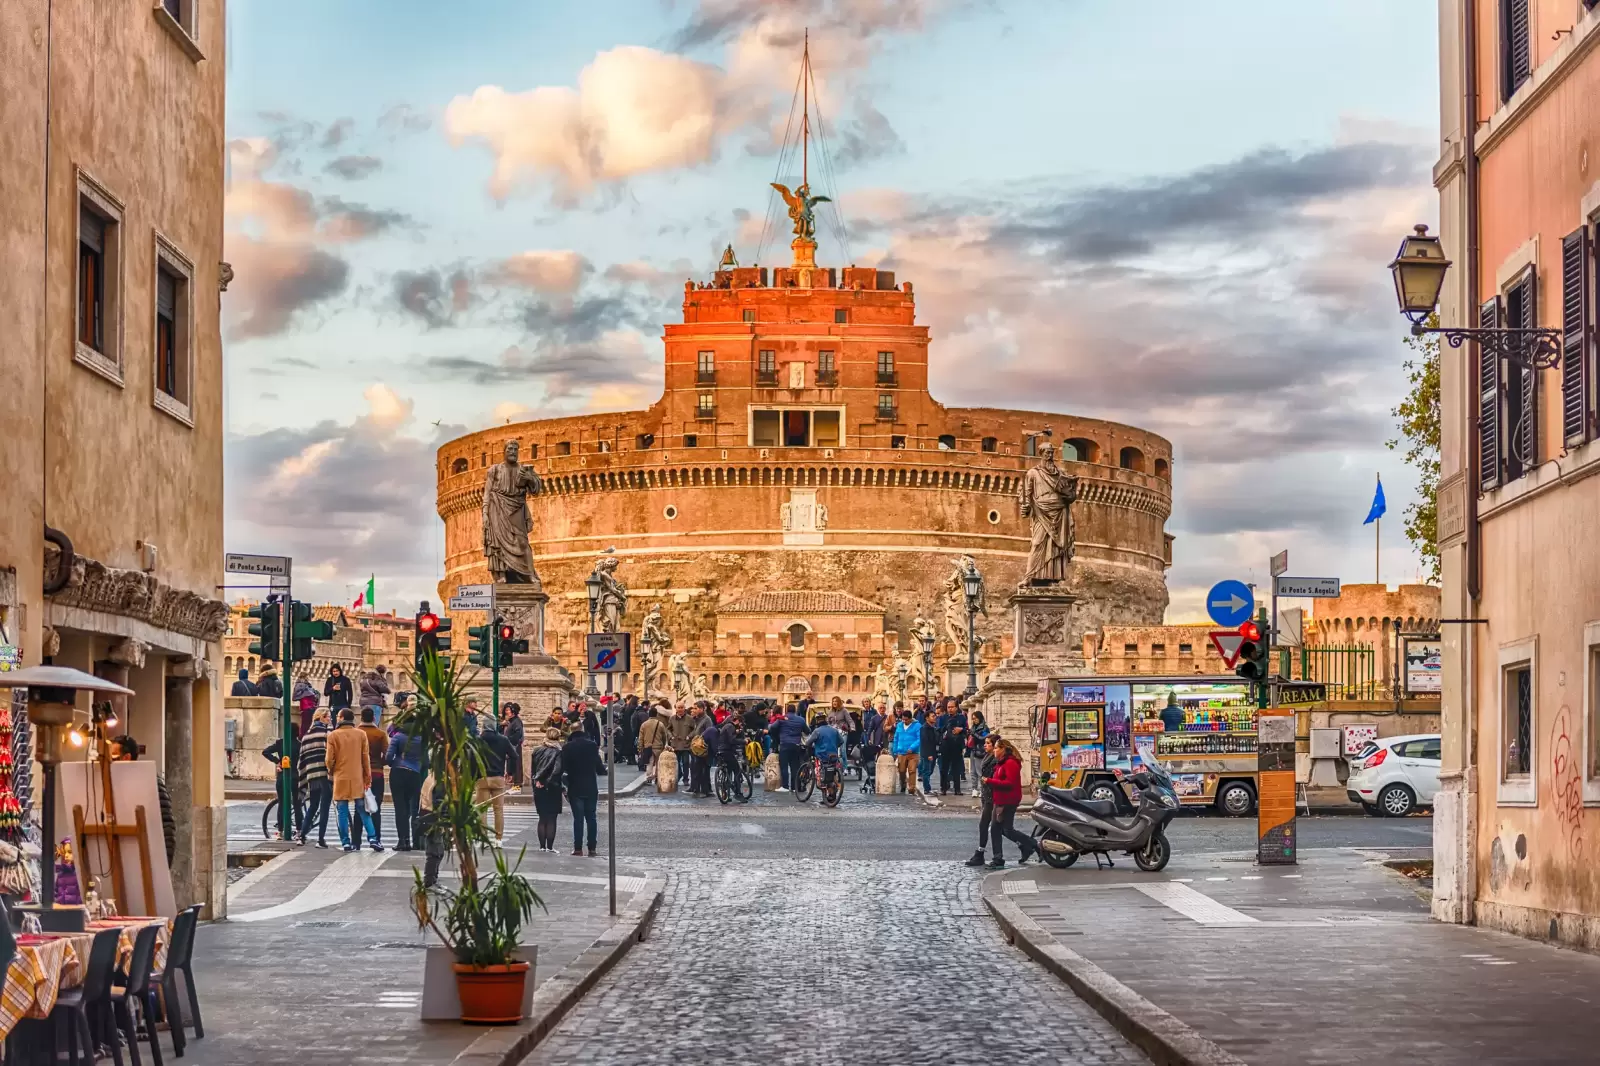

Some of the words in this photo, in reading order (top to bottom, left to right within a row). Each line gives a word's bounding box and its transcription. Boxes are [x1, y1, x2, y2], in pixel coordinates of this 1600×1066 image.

[229, 562, 236, 570] di
[237, 563, 255, 571] Ponte
[1281, 586, 1287, 594] di
[1289, 586, 1306, 594] Ponte
